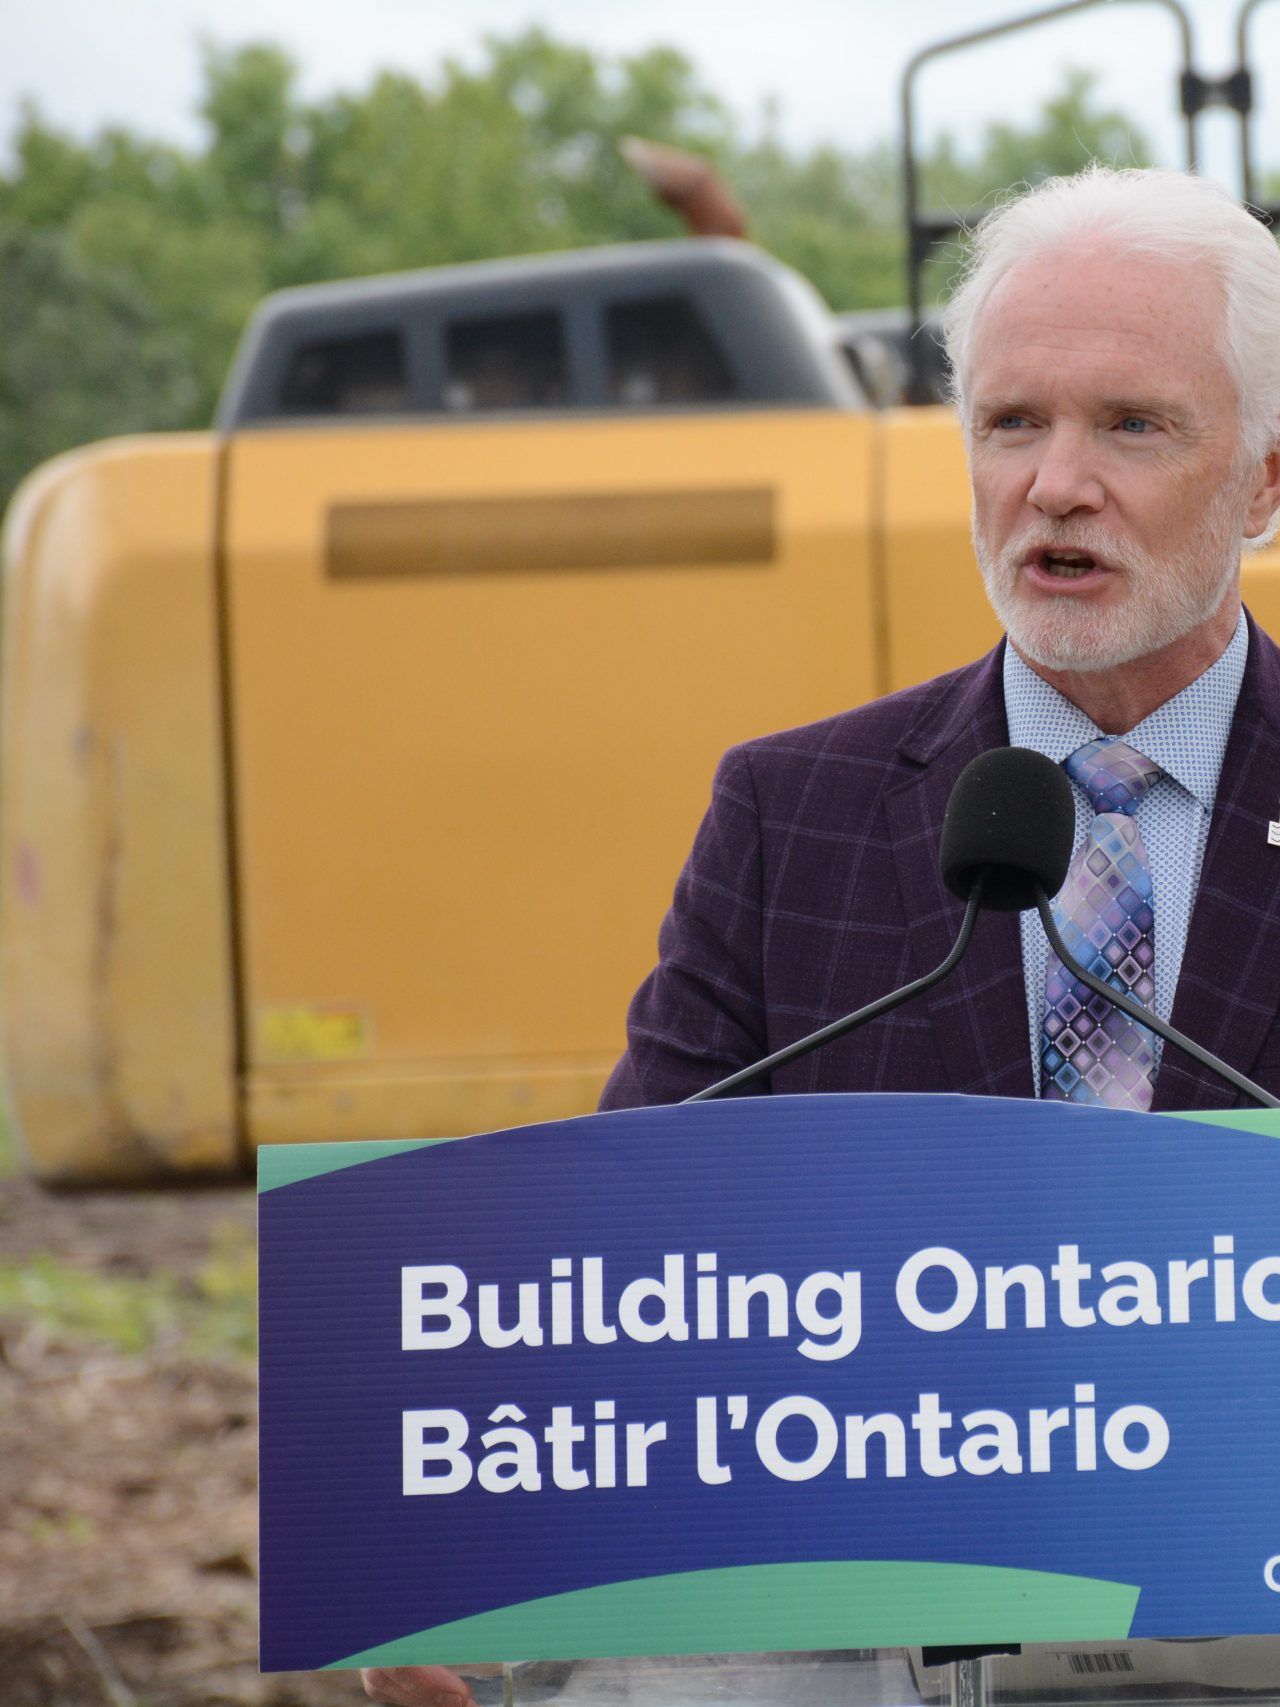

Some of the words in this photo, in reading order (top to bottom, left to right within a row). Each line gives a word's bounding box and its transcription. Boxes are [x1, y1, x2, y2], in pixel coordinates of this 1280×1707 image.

[401, 1253, 862, 1361] Building
[402, 1401, 667, 1495] Bâtir
[696, 1384, 1170, 1485] l’Ontario
